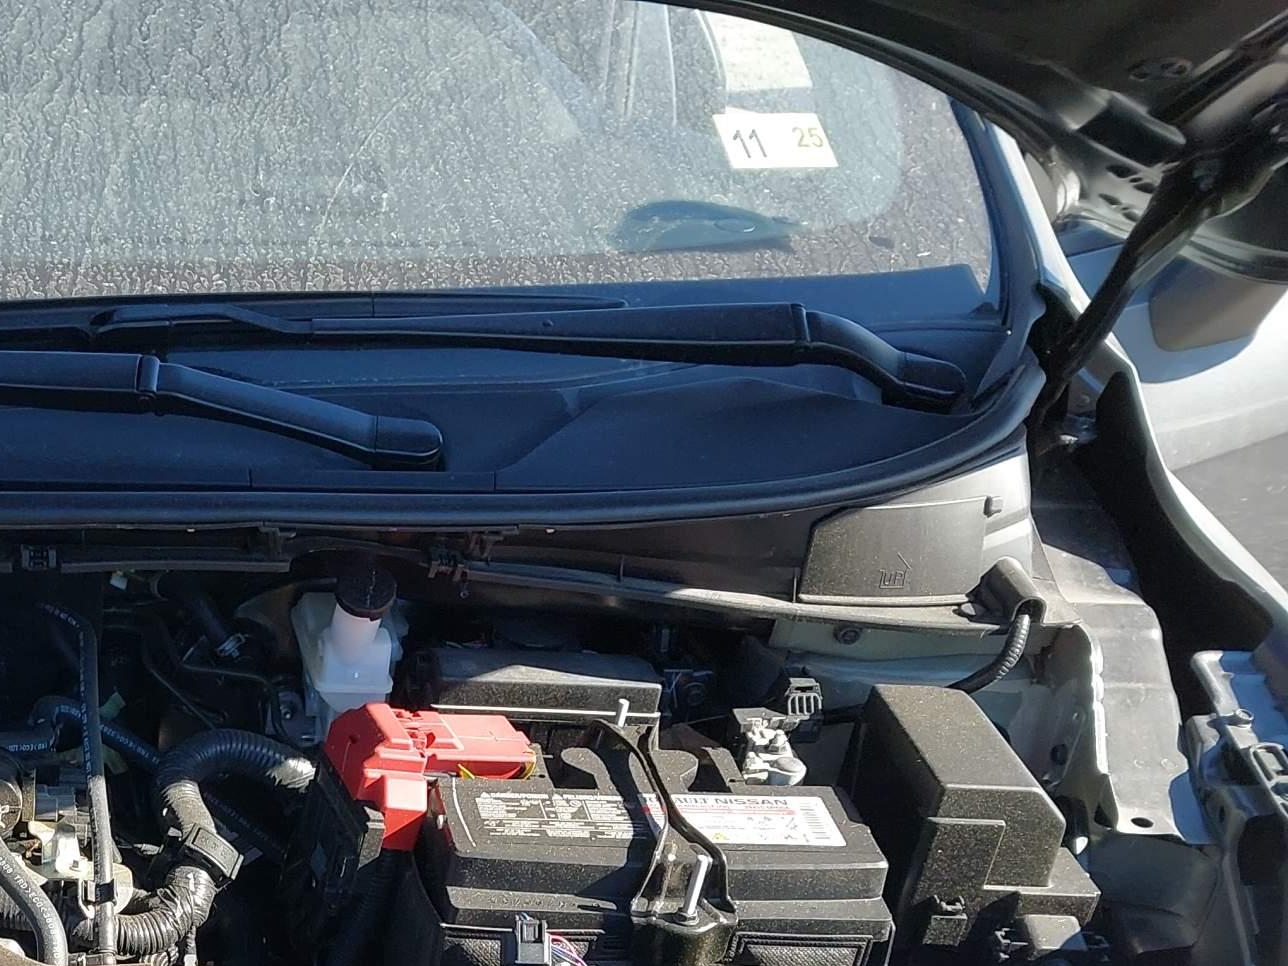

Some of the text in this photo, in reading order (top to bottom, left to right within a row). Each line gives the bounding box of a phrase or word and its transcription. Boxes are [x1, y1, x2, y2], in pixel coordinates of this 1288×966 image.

[732, 126, 824, 158] 11 25
[715, 797, 788, 806] NISSAN
